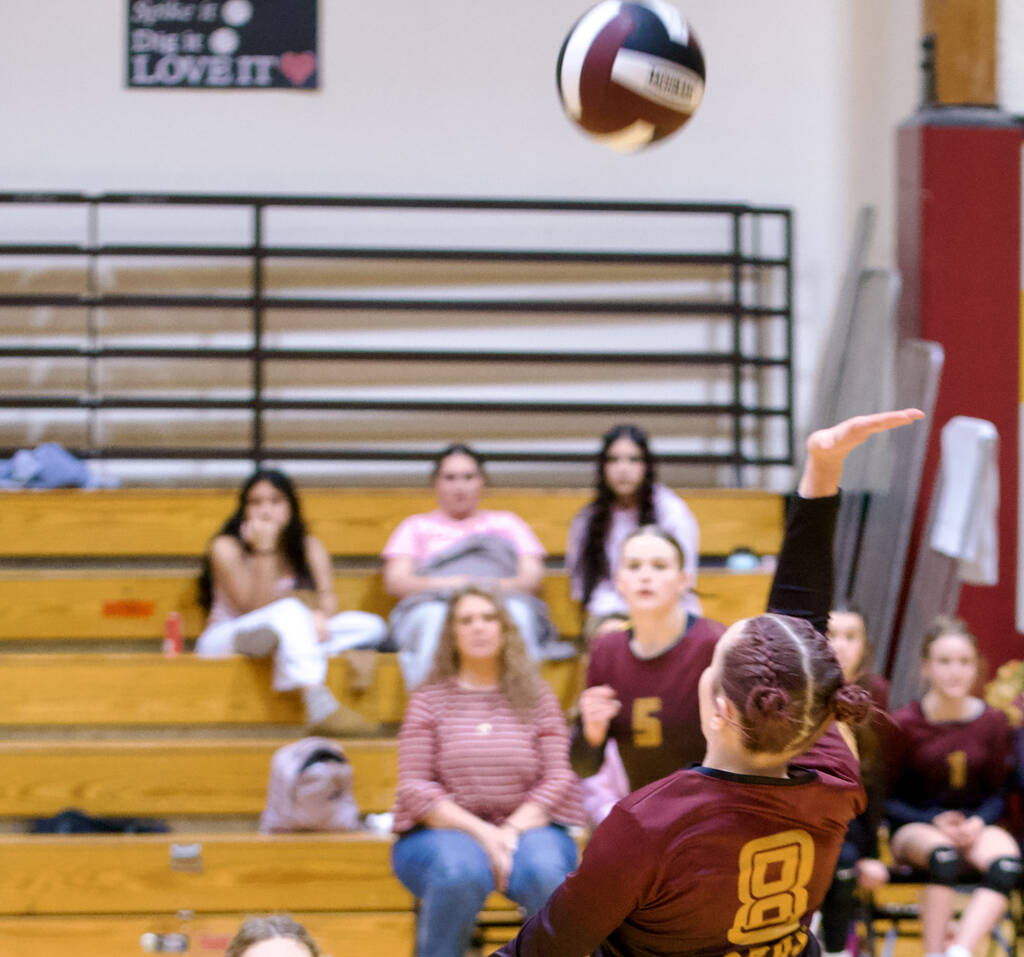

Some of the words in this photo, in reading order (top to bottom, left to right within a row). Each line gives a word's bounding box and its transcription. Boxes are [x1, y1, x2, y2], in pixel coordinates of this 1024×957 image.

[132, 54, 235, 86] LOVE
[236, 54, 280, 86] IT
[632, 697, 662, 748] 5
[727, 829, 815, 945] 8
